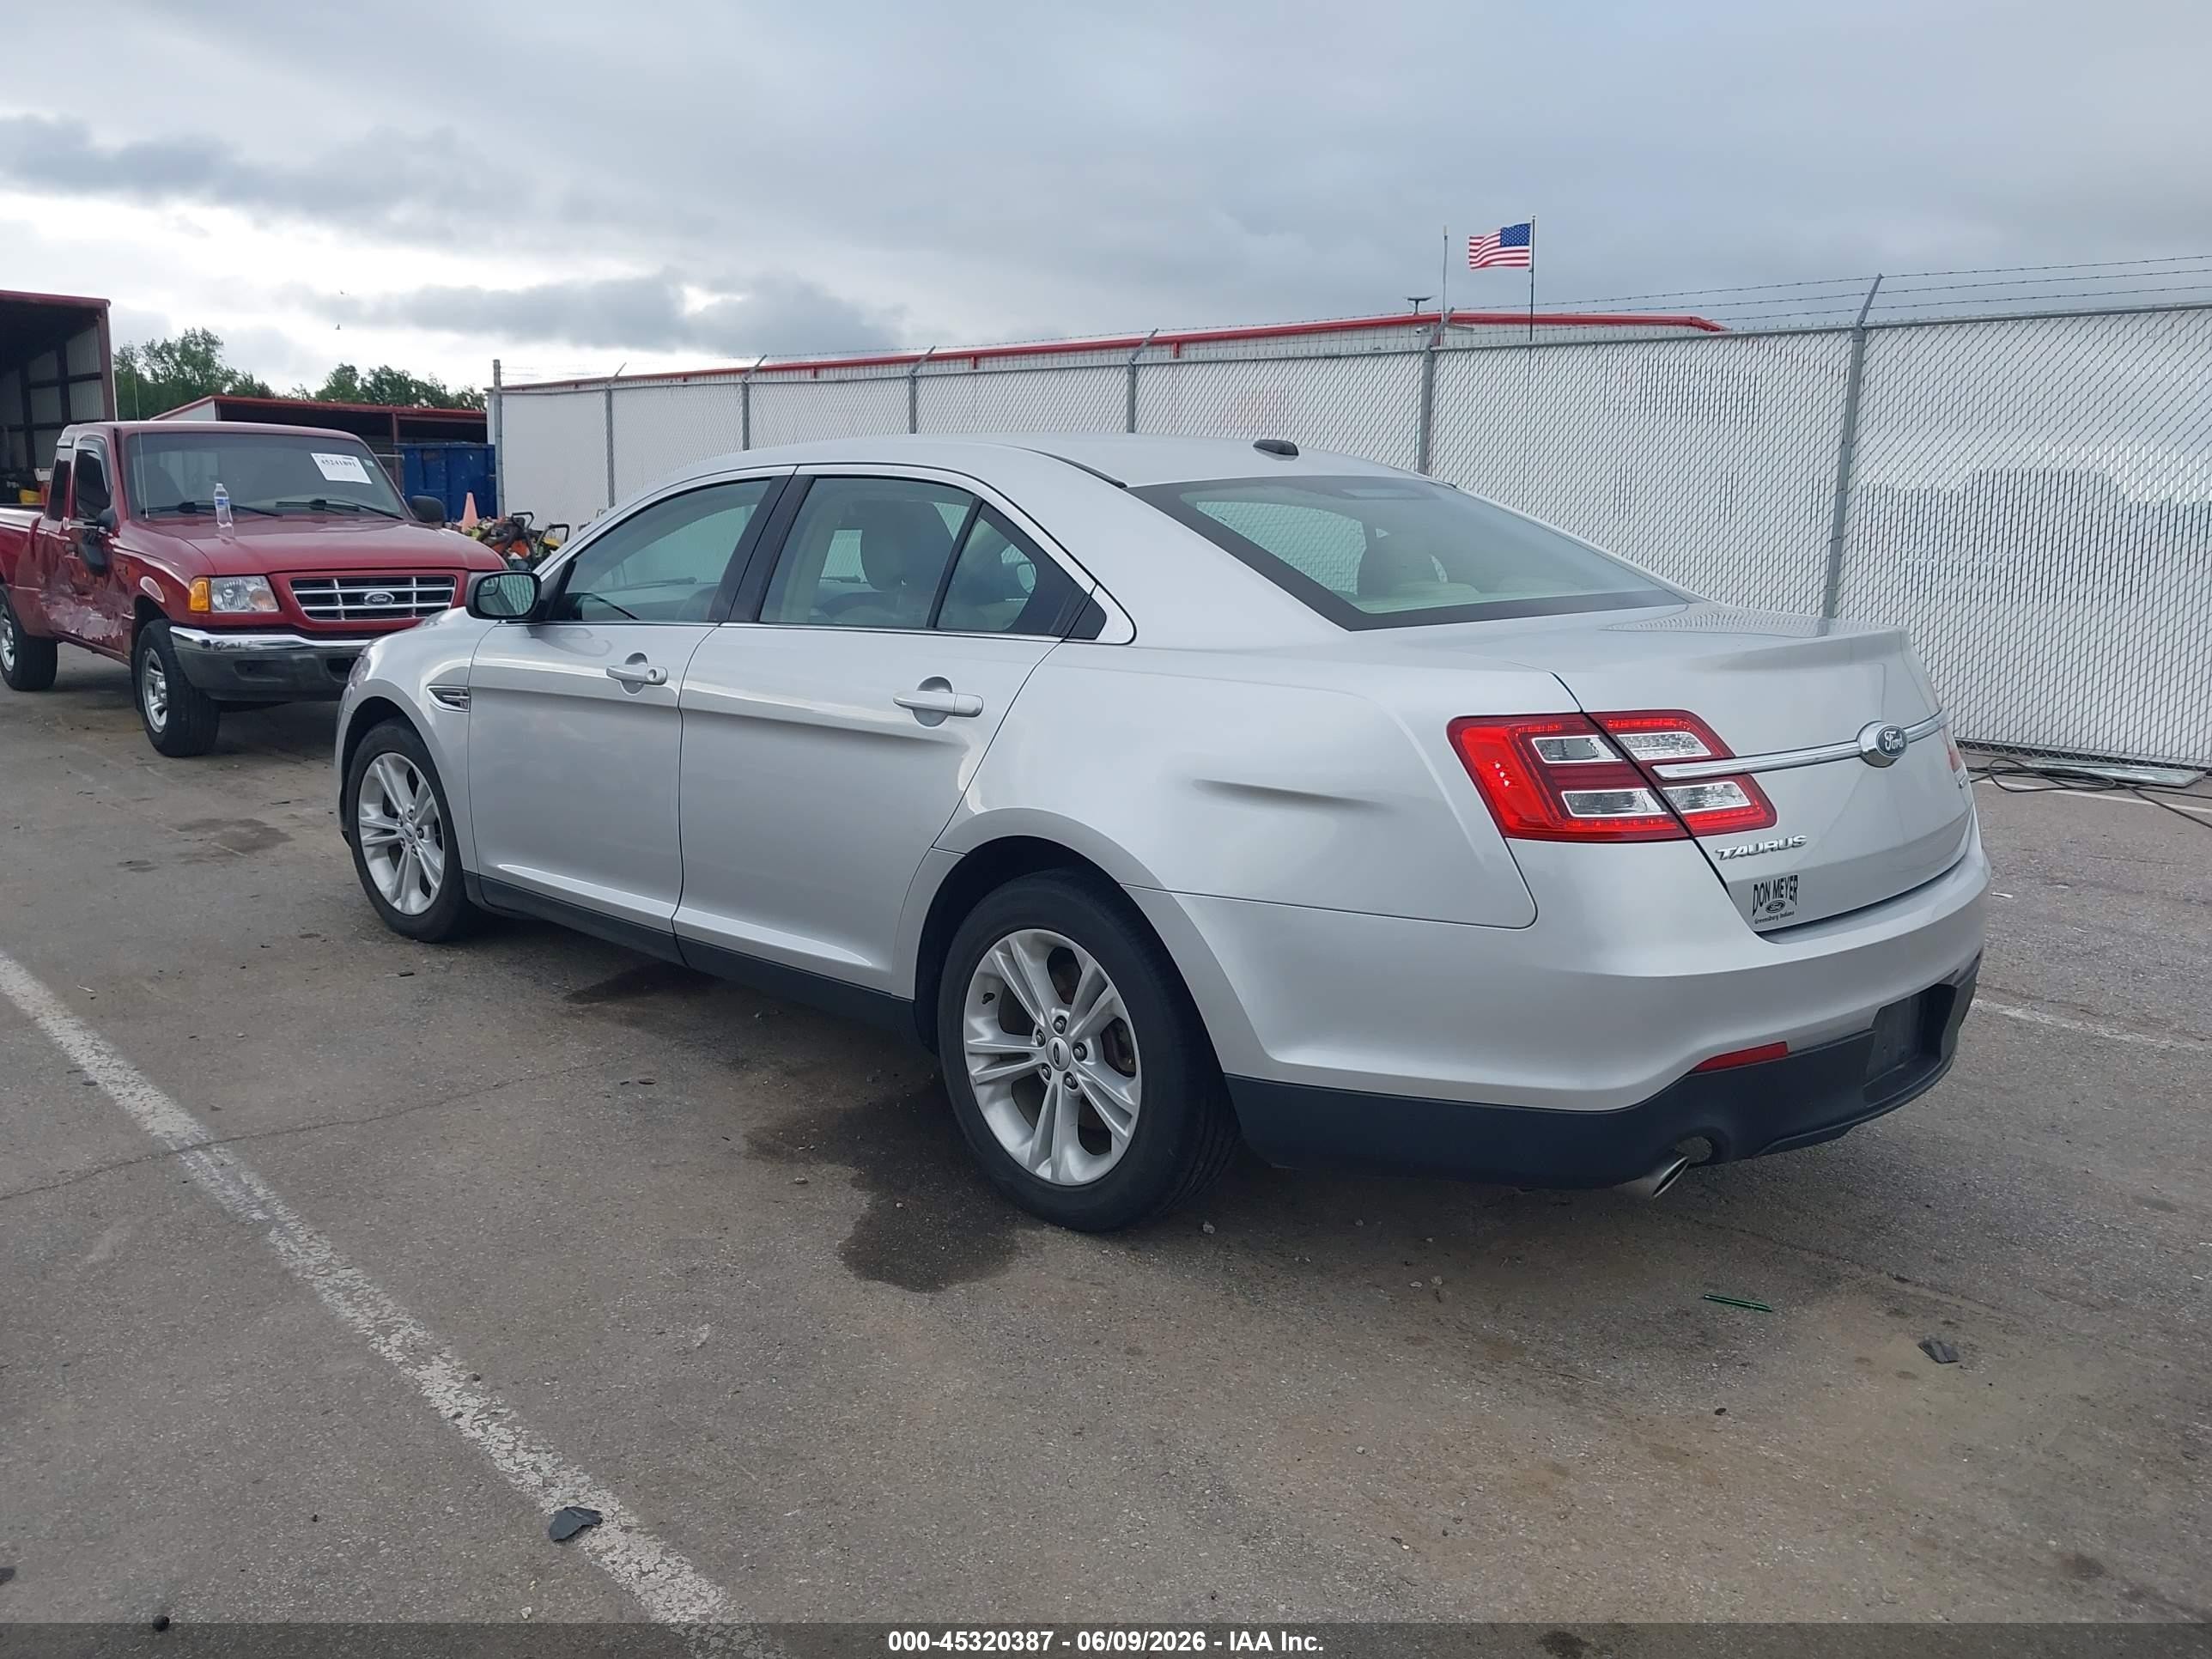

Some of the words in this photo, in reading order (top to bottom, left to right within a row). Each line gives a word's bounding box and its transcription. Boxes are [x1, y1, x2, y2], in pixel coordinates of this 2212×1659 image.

[1884, 730, 1904, 751] Ford
[1716, 835, 1807, 860] TAURUS
[1752, 881, 1771, 916] DON
[1772, 874, 1799, 906] MEYER
